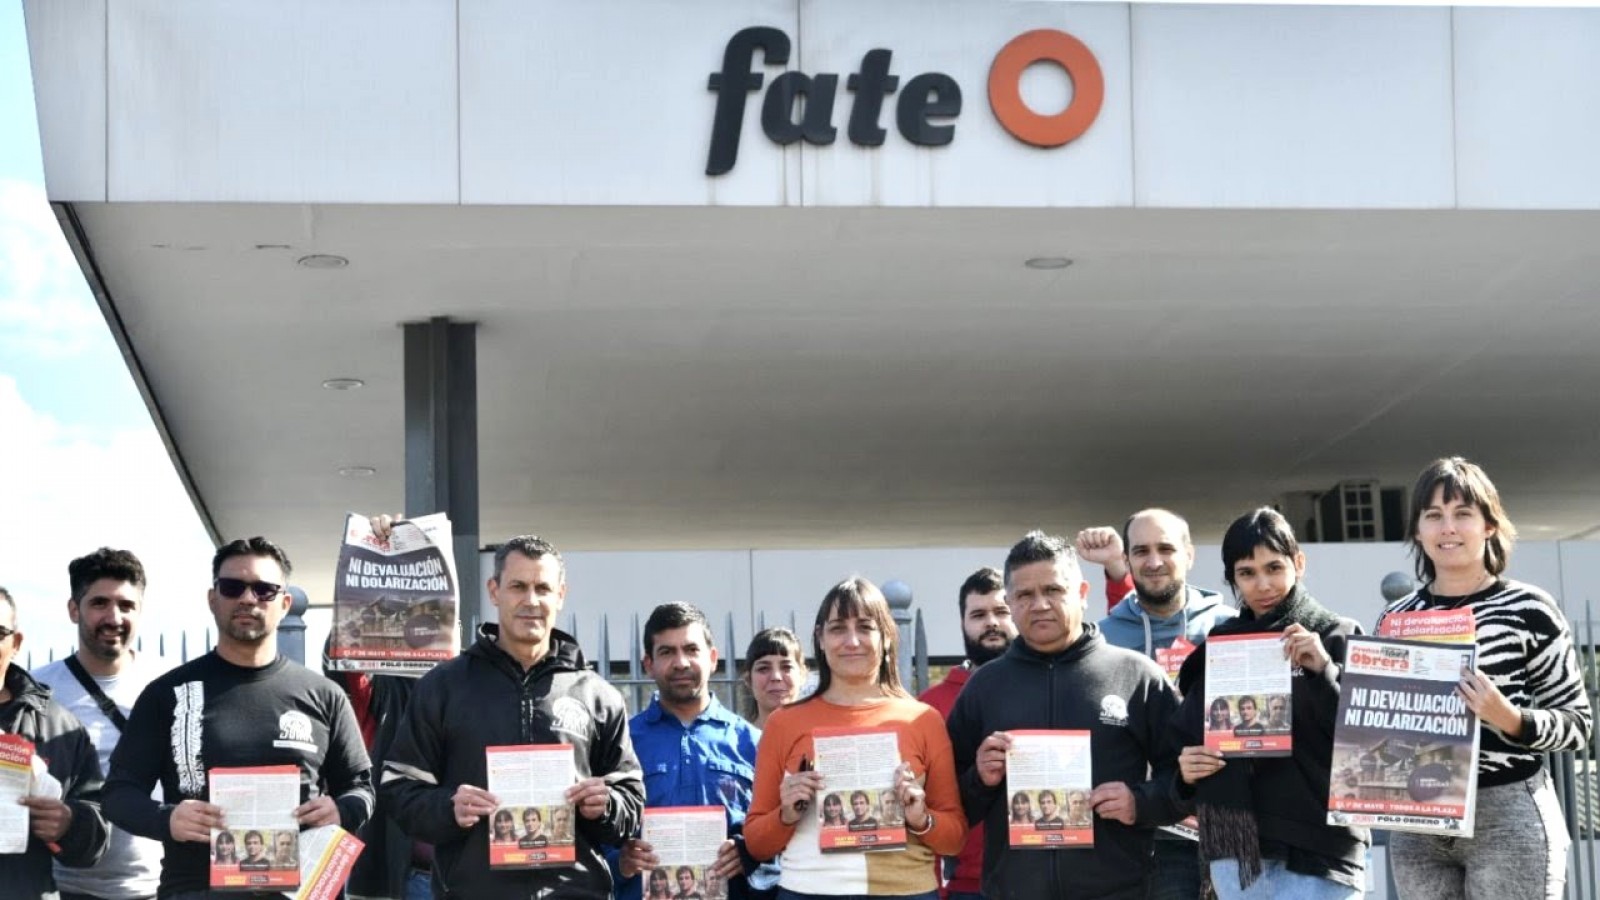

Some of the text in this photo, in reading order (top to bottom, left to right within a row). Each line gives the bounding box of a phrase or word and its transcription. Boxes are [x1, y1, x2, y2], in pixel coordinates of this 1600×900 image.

[705, 26, 962, 176] fate
[348, 556, 443, 577] NI DEVALUACIÓN
[345, 573, 448, 591] NI DOLARIZACIÓN
[1350, 653, 1410, 670] Obrera
[1351, 687, 1466, 715] NI DEVALUACIÓN
[1345, 708, 1468, 736] NI DOLARIZACIÓN
[1403, 817, 1439, 825] OBRERO
